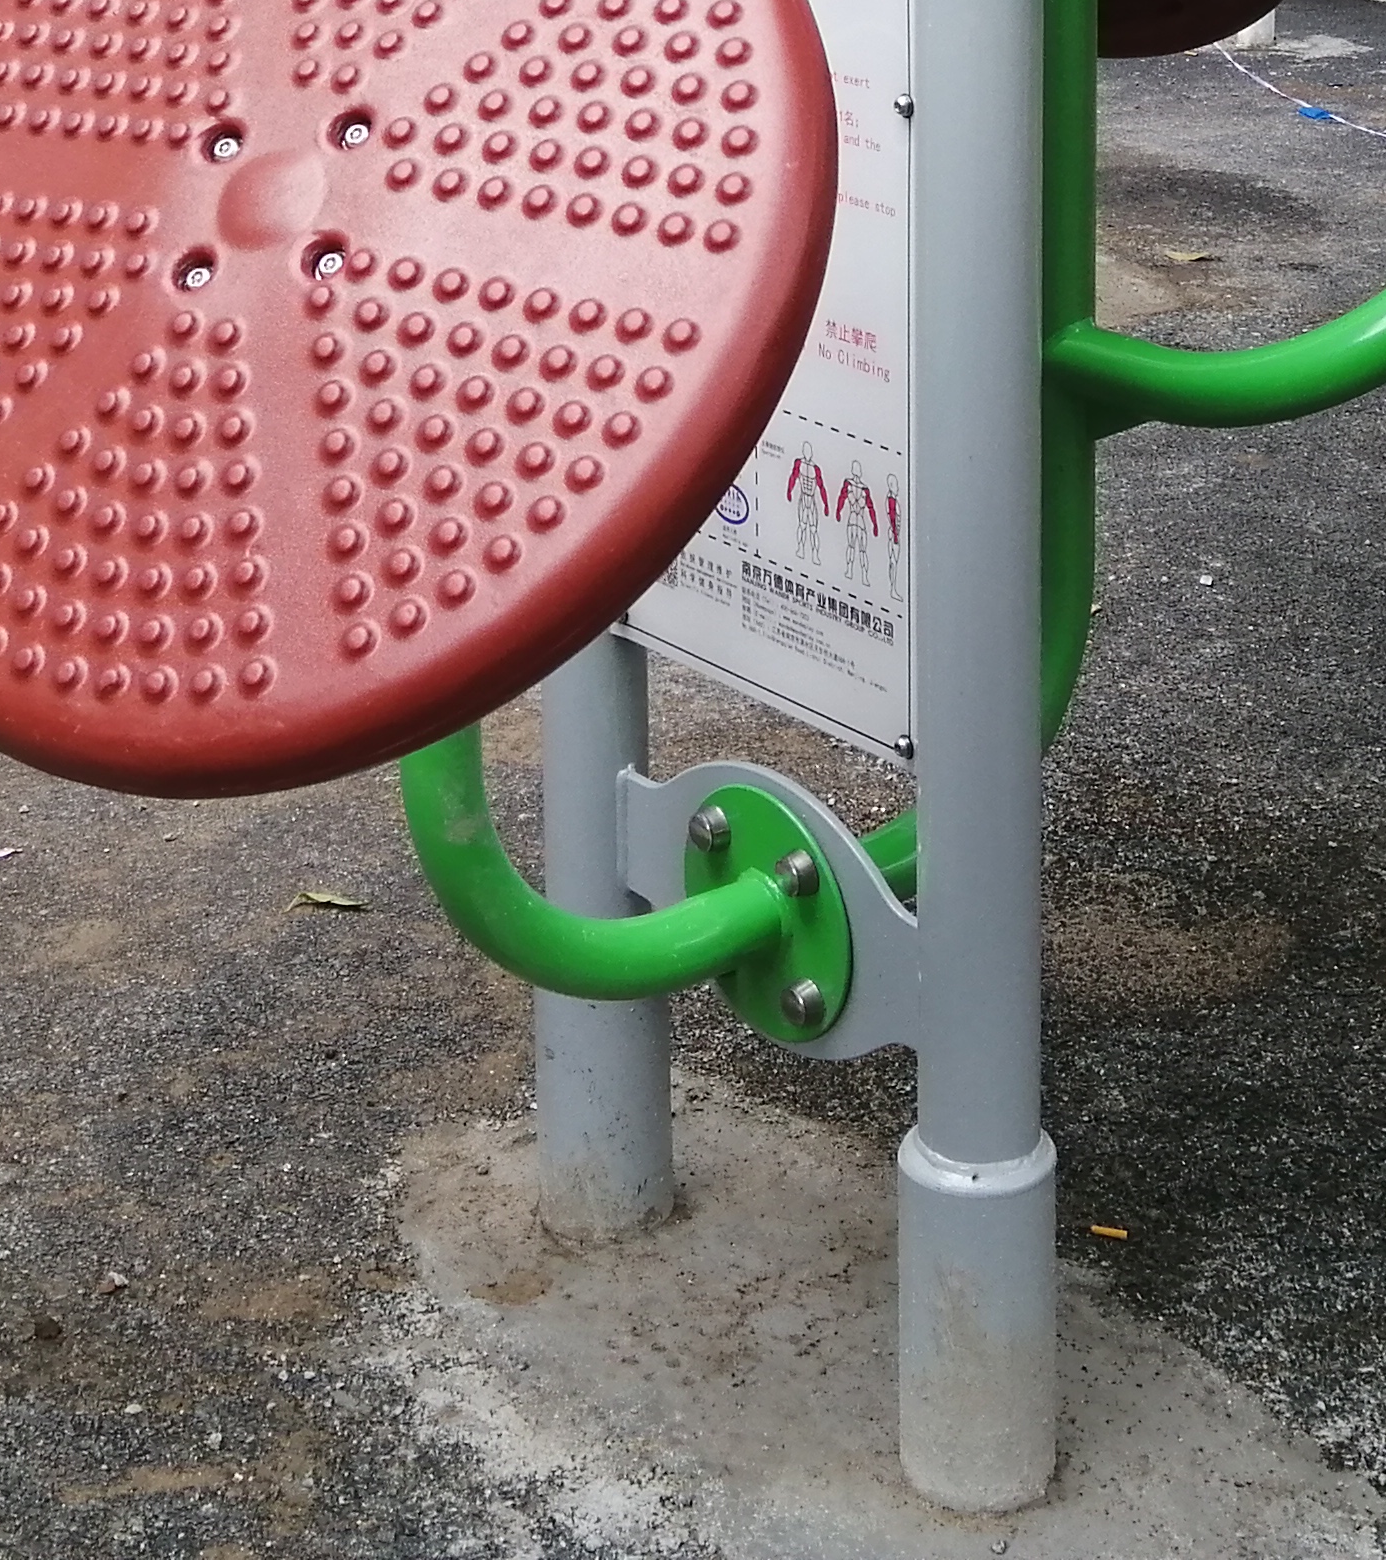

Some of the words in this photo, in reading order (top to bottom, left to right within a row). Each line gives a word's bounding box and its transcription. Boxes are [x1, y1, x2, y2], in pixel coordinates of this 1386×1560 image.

[843, 75, 871, 89] exert
[843, 134, 860, 147] and
[865, 137, 882, 152] the
[838, 192, 870, 210] please
[875, 202, 896, 218] stop
[825, 319, 877, 353] 禁止攀爬
[818, 342, 832, 360] No
[837, 349, 891, 383] Climbing
[741, 560, 894, 639] 南京万德体育产业集团有限公司
